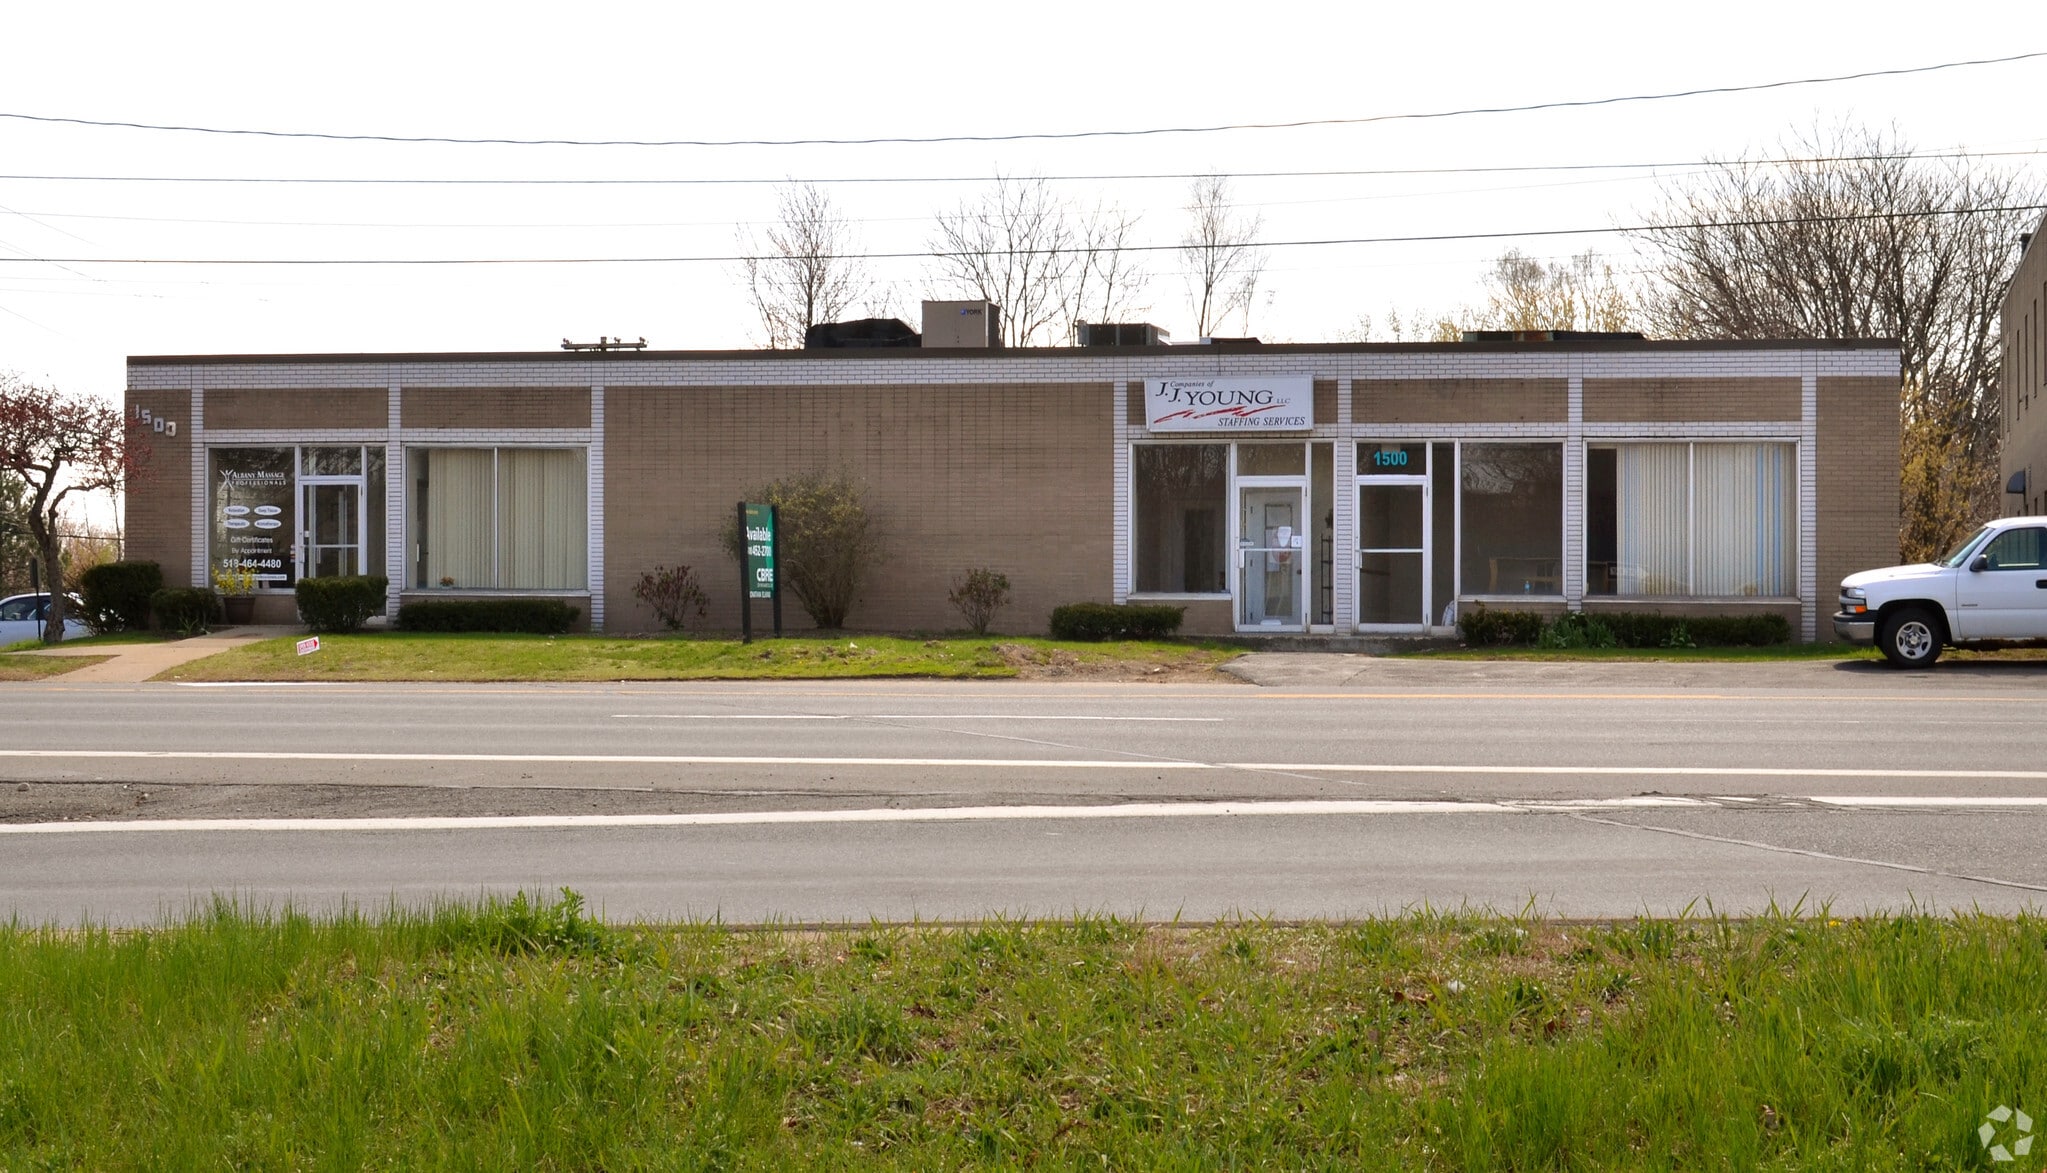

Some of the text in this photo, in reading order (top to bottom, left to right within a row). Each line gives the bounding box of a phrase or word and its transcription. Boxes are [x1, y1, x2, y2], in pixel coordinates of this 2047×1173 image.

[1170, 380, 1214, 389] Companies of
[135, 404, 177, 437] 1500
[1218, 416, 1305, 427] STAFFING SERVICES
[1373, 450, 1408, 466] 1500
[231, 471, 255, 479] ALBANY
[746, 525, 771, 541] Available
[242, 536, 273, 544] Certificates
[223, 559, 282, 568] 518-464-4480
[757, 568, 774, 582] CBRE
